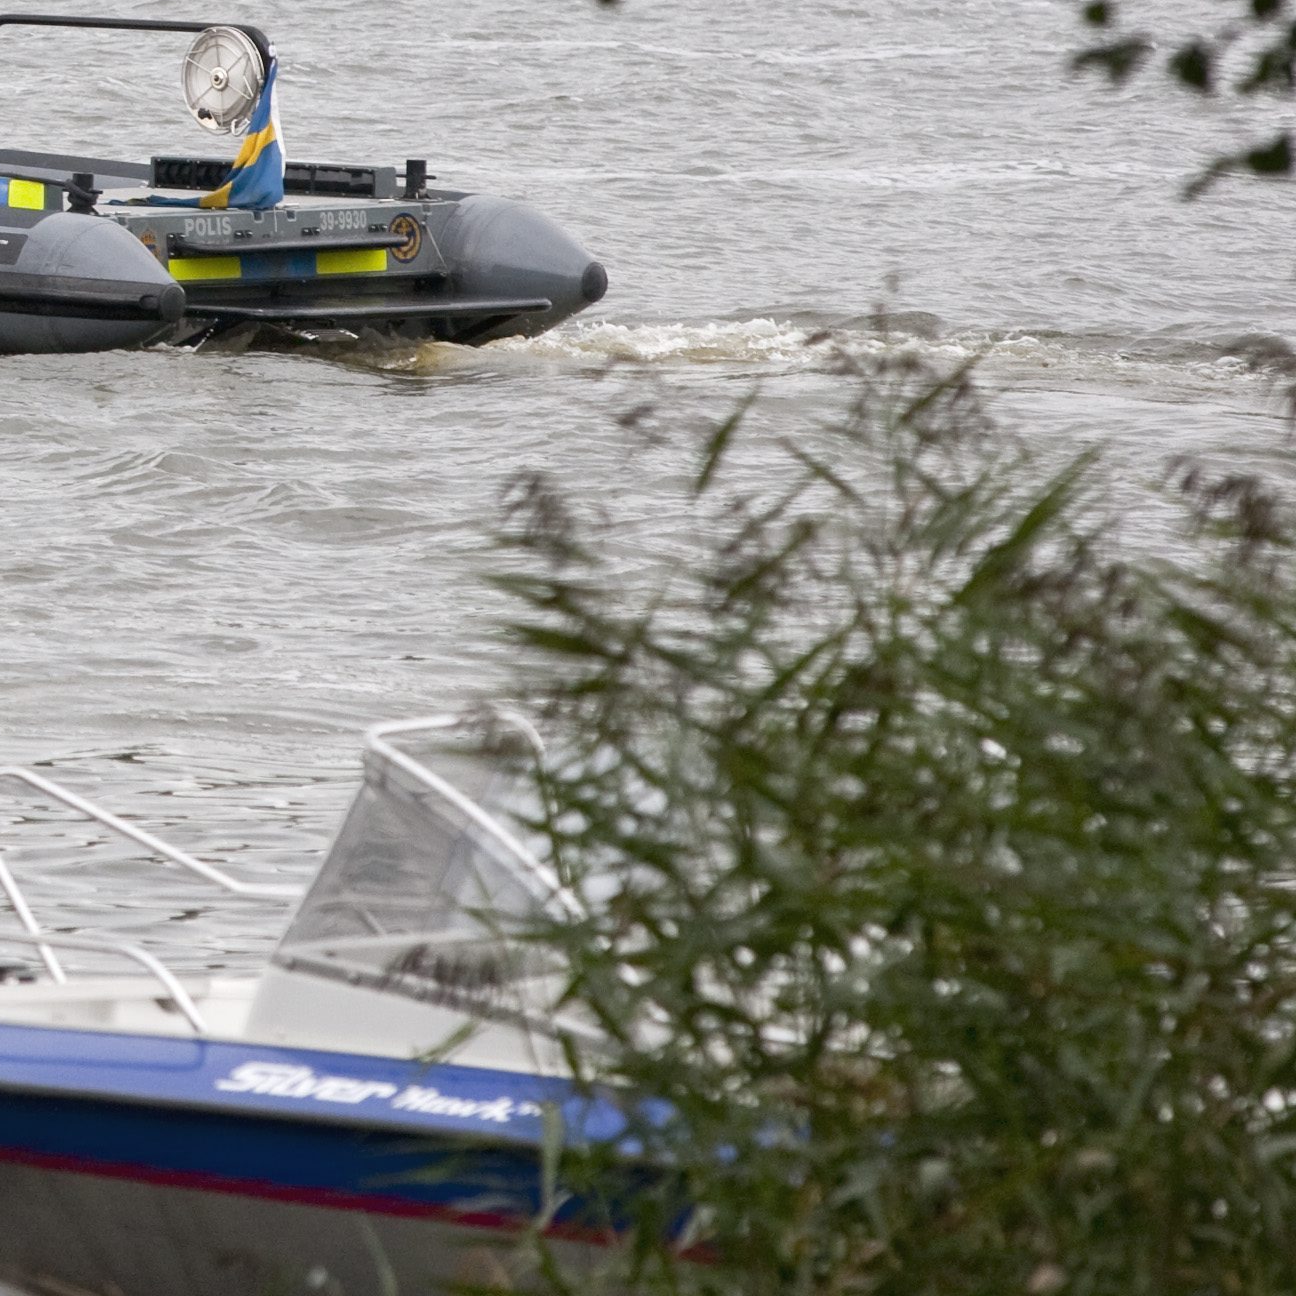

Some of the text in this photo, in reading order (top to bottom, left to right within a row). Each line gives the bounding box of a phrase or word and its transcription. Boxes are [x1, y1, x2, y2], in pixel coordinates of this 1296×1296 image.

[184, 216, 232, 237] POLIS
[319, 210, 368, 230] 39-9930
[214, 1061, 397, 1104] Silver
